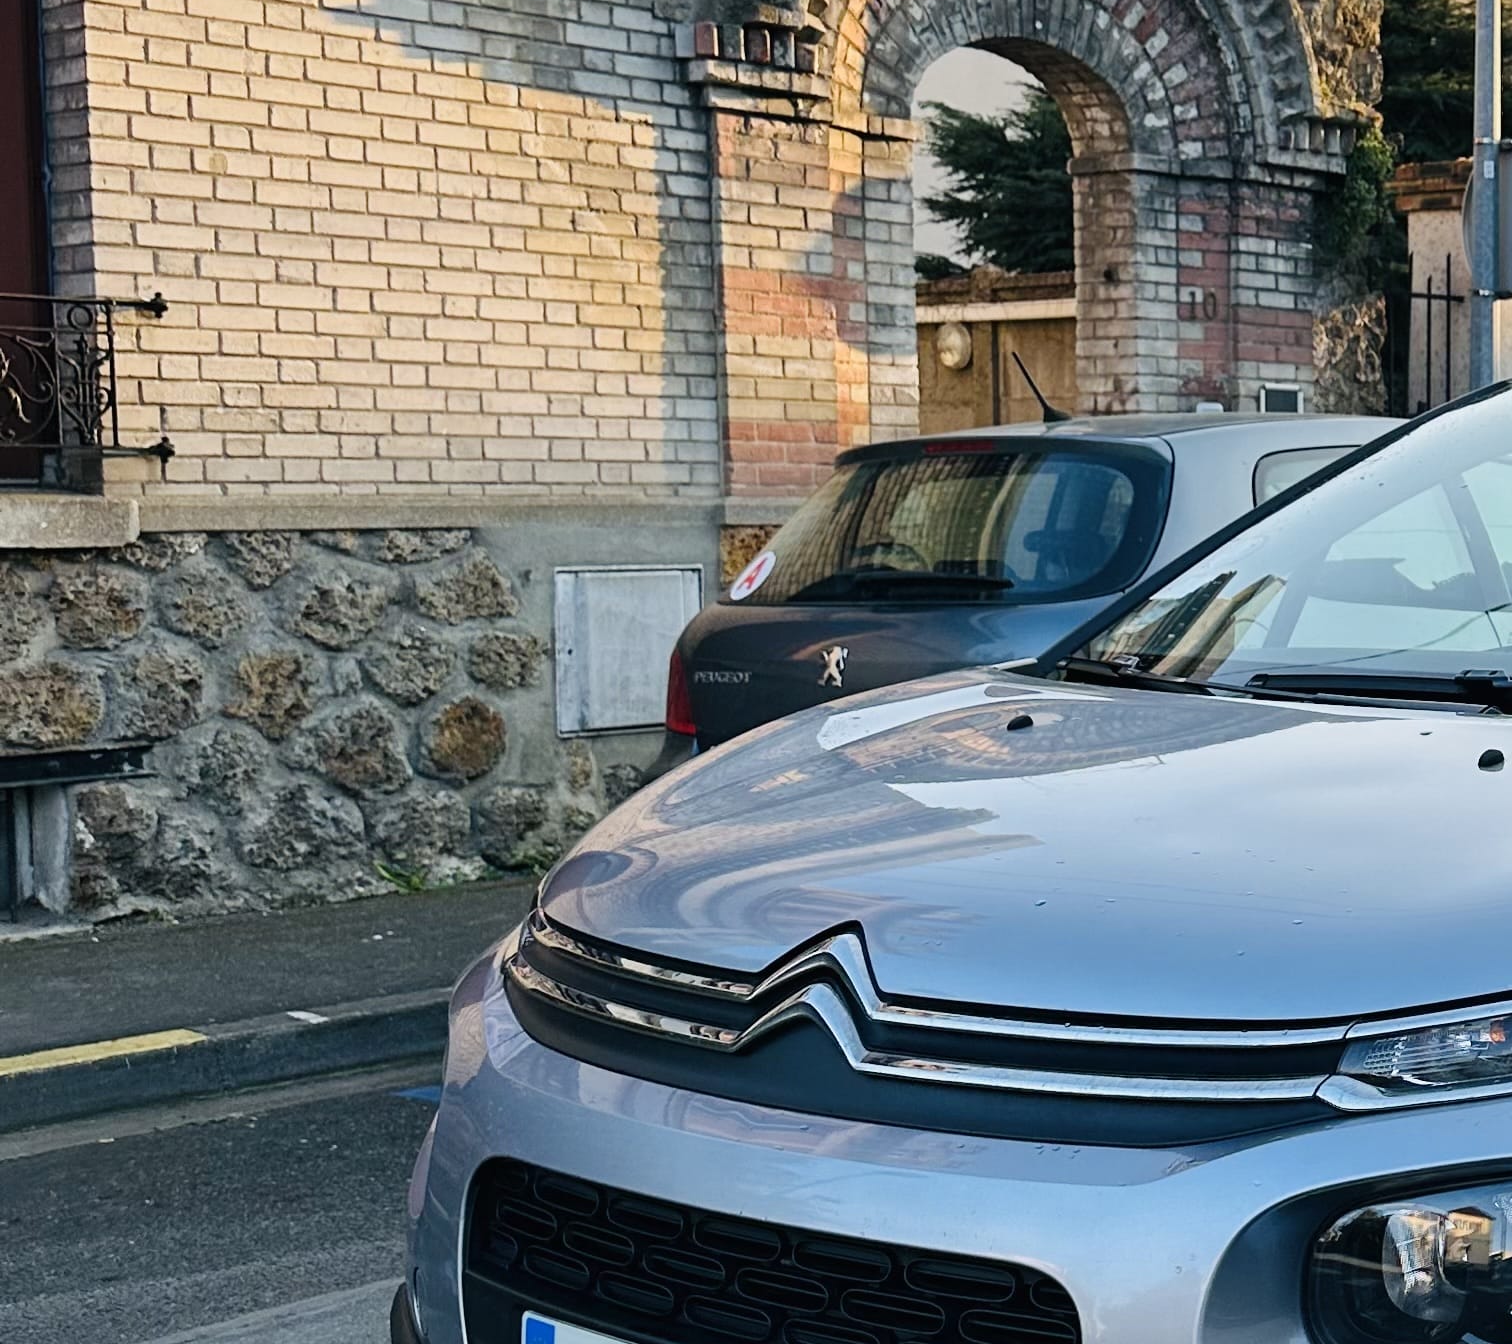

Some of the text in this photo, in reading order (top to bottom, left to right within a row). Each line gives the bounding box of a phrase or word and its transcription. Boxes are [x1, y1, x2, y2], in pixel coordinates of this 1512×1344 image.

[1188, 290, 1217, 321] 10
[736, 557, 768, 591] A
[694, 671, 753, 684] PEUGEOT
